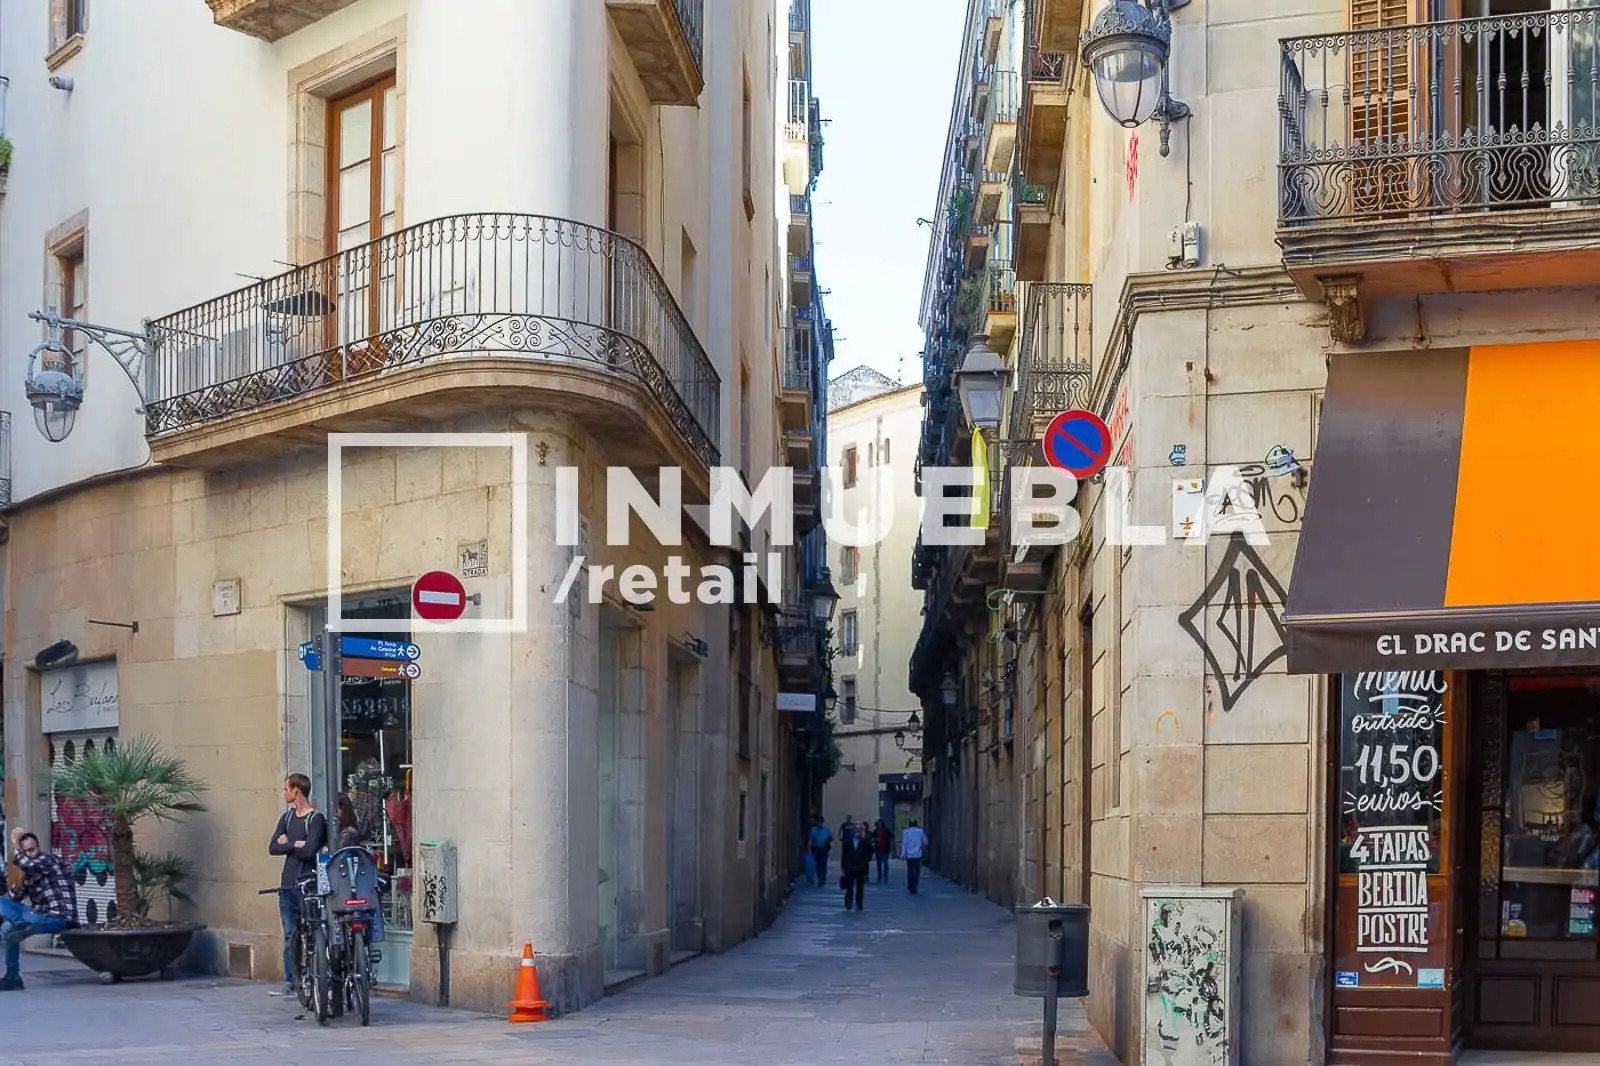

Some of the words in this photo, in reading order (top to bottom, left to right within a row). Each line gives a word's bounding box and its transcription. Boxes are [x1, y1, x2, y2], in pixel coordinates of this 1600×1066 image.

[1376, 634, 1407, 656] EL
[1414, 631, 1486, 655] DRAC
[1494, 630, 1532, 652] DE
[1540, 627, 1600, 650] SAN
[1355, 743, 1439, 787] 11,50
[1357, 788, 1433, 812] euros
[1358, 871, 1429, 907] BEBIDA
[1358, 913, 1429, 946] POSTRE
